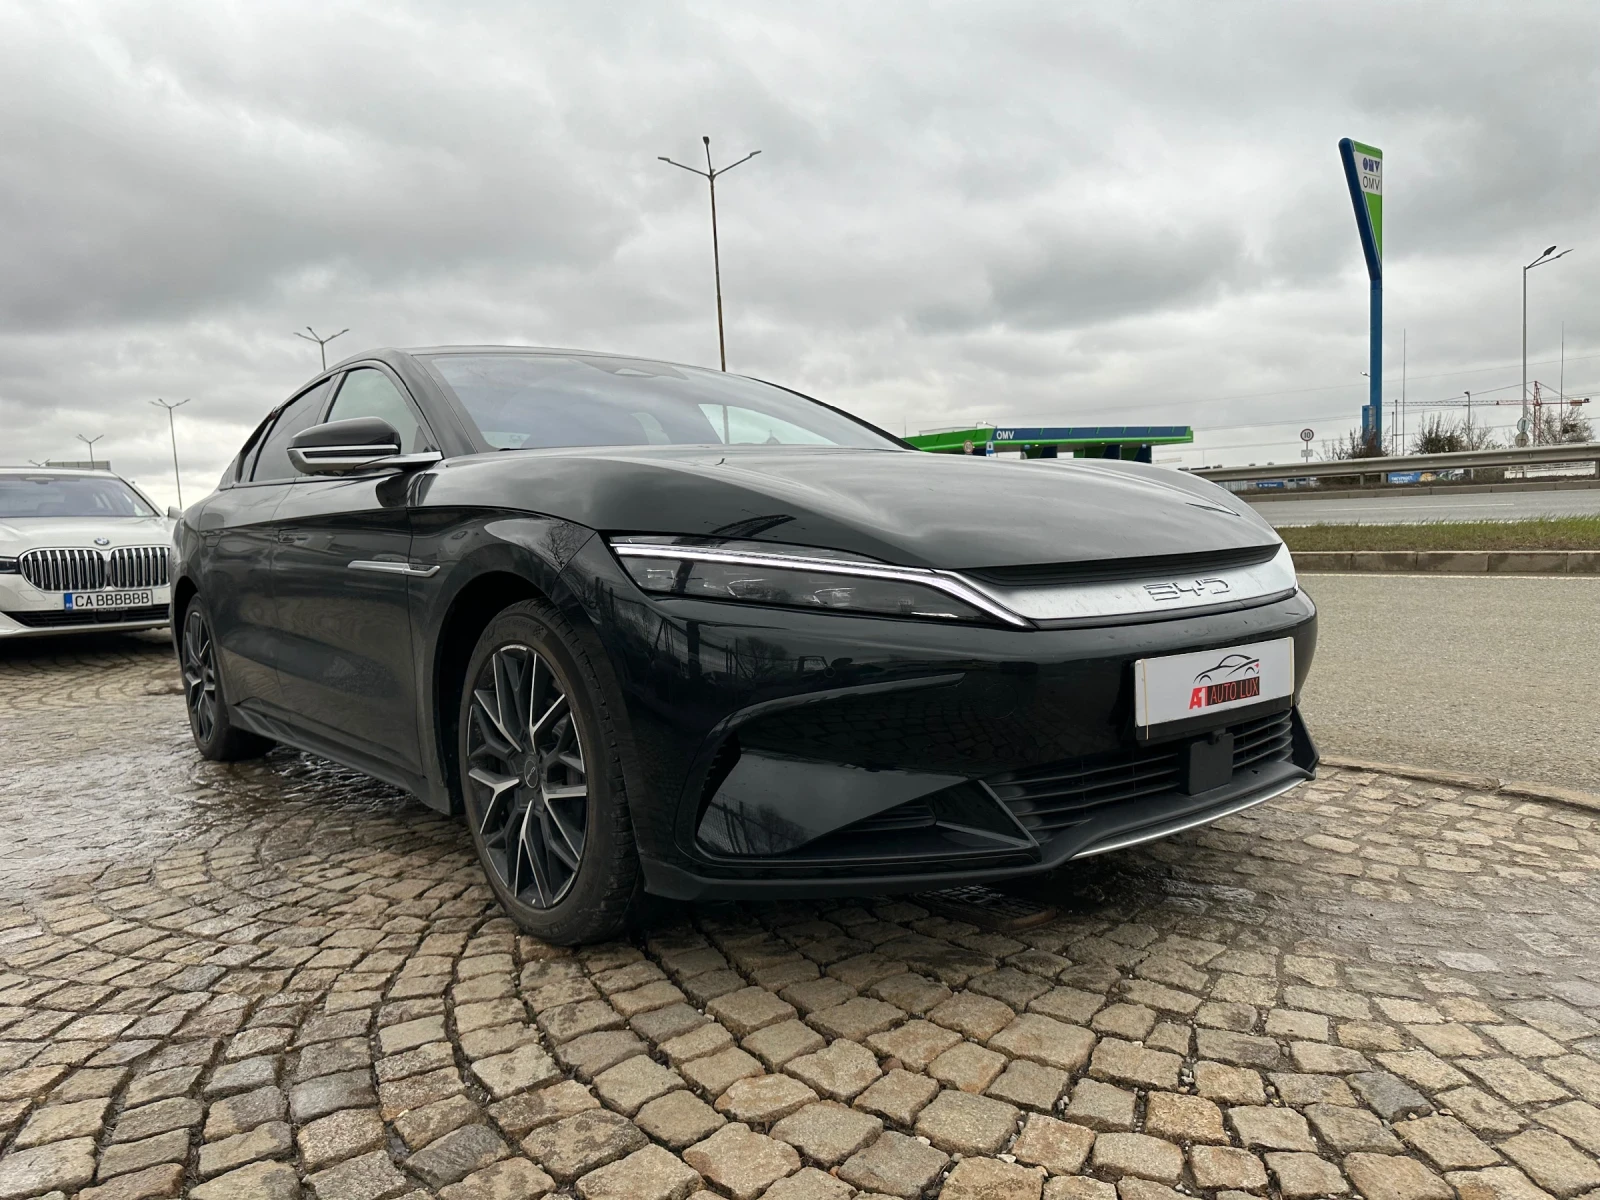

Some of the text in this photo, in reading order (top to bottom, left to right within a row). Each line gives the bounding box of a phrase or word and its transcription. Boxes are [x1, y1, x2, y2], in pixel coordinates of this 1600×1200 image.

[1363, 157, 1380, 173] OMV
[1363, 176, 1380, 191] OMV
[996, 430, 1015, 440] OMV
[75, 592, 150, 607] CA BBBBBB
[1189, 678, 1259, 710] A1 AUTO LUX
